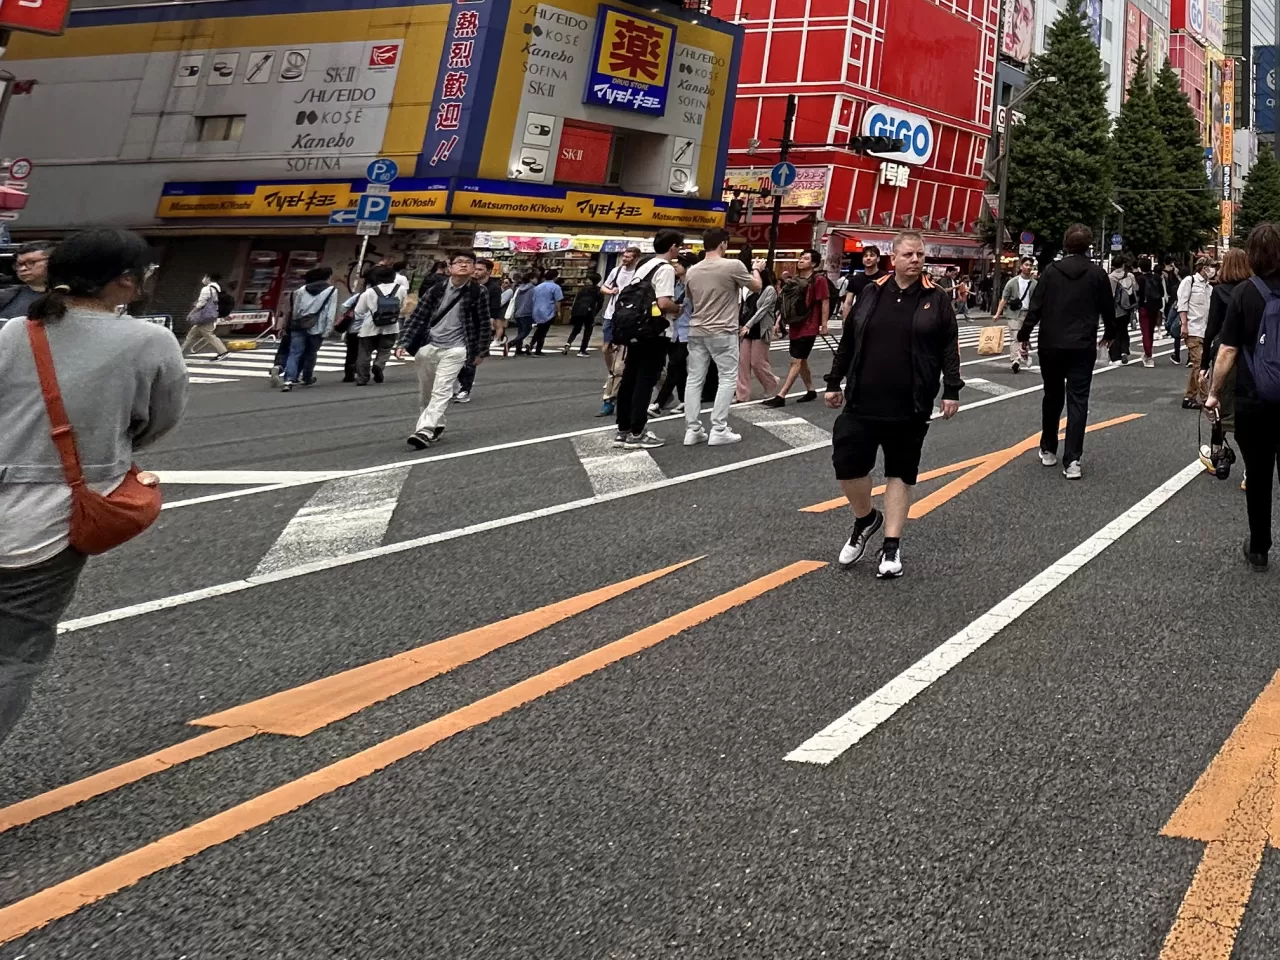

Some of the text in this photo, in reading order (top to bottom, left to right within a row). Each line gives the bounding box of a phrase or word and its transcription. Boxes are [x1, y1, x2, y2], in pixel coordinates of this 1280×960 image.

[519, 3, 588, 32] SHISEIDO
[520, 41, 575, 65] Kanebo
[608, 18, 665, 82] 薬
[675, 46, 726, 68] SHISEIDO
[520, 61, 568, 82] SOFINA
[612, 77, 650, 91] DRUG STORE
[676, 78, 716, 97] Kanebo
[293, 87, 377, 104] SHISEIDO
[677, 94, 712, 111] SOFINA
[291, 132, 356, 150] Kanebo
[286, 156, 341, 173] SOFINA
[371, 163, 387, 180] P
[880, 162, 911, 188] 1号館
[363, 196, 386, 219] P
[401, 197, 437, 208] KiYoshi
[470, 198, 564, 216] Matsumoto KiYoshi
[651, 211, 692, 223] Matsumoto
[536, 241, 559, 251] SALE
